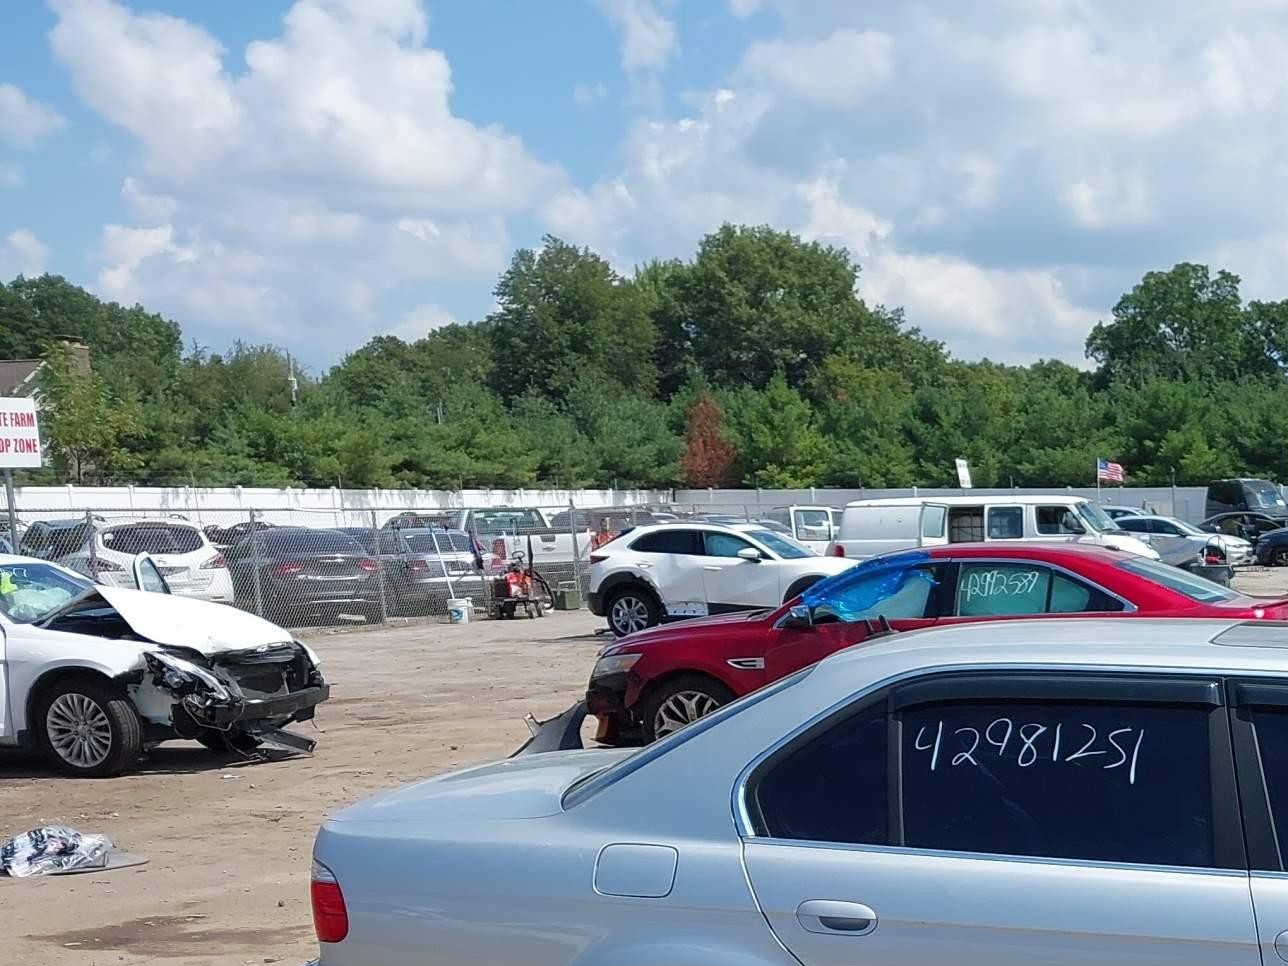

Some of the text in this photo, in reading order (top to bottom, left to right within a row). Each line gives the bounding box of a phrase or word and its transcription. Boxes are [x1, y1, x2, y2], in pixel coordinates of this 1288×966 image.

[10, 412, 35, 427] FARM
[13, 438, 38, 453] ZONE
[914, 718, 1144, 784] 42981251
